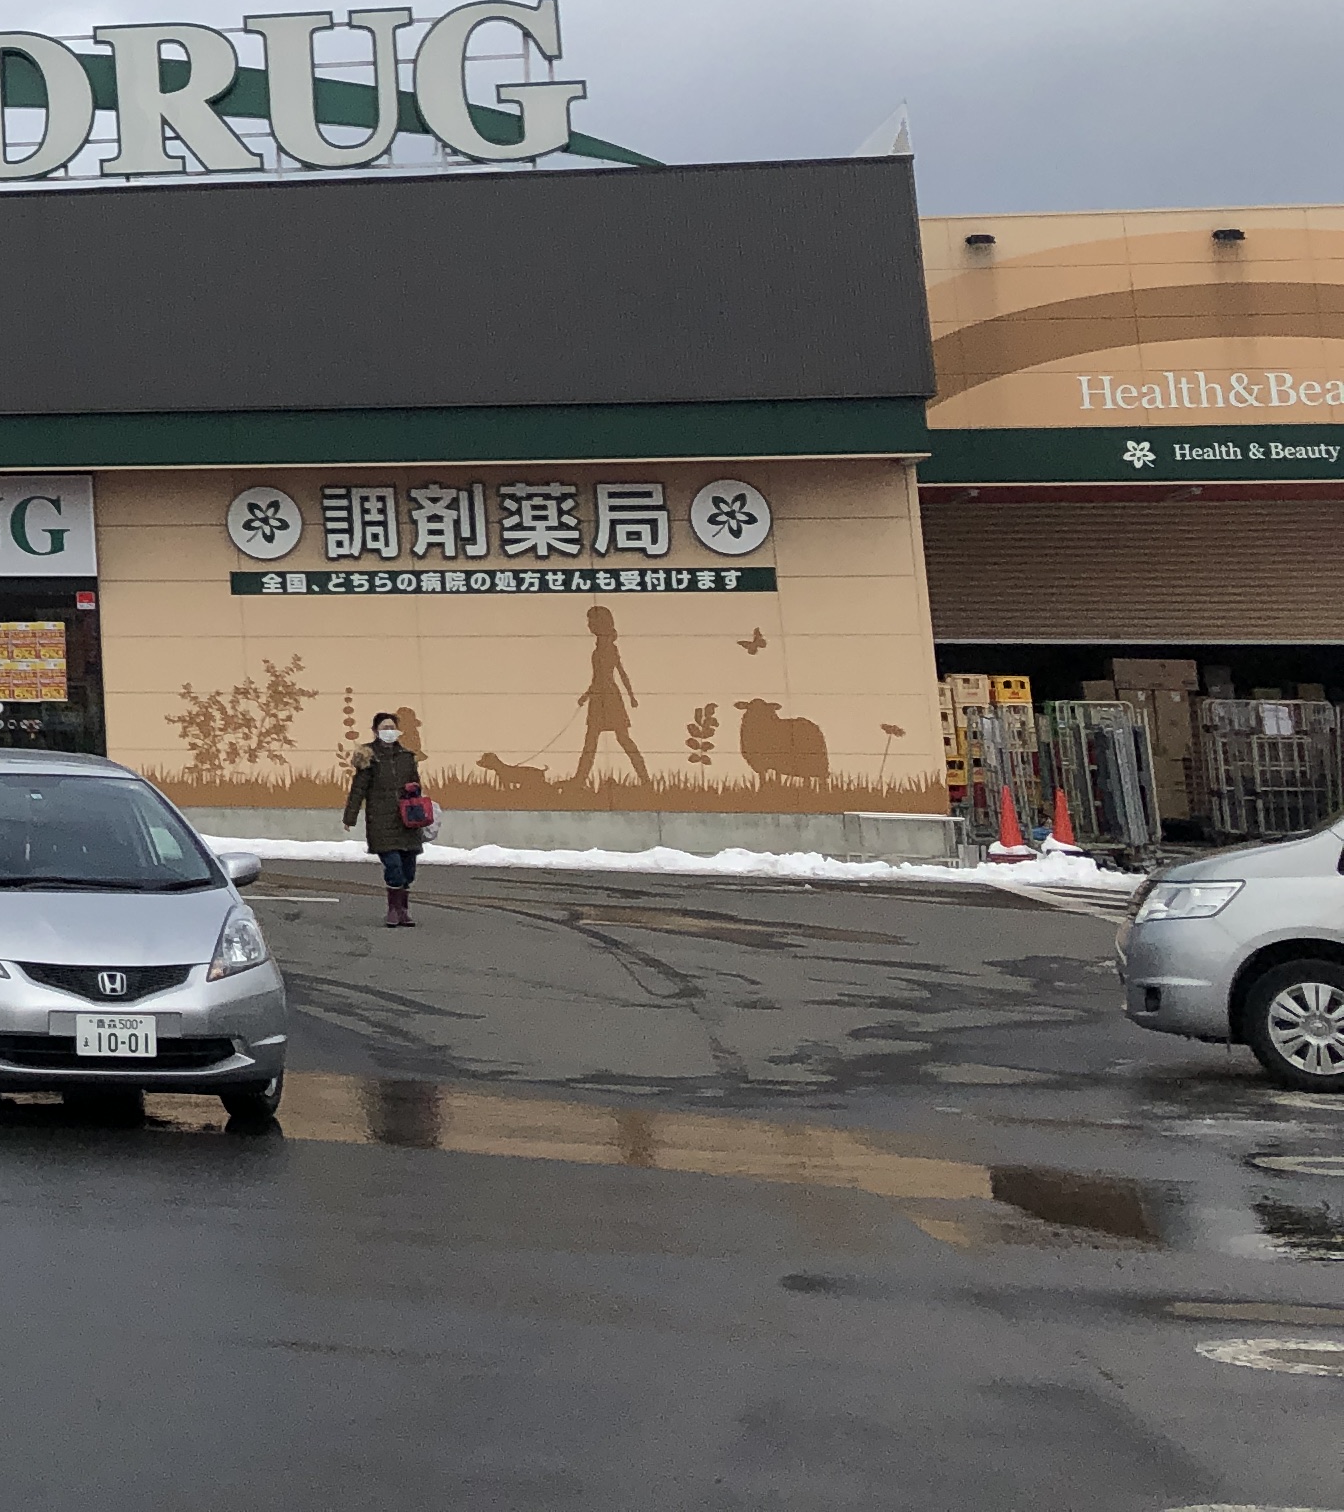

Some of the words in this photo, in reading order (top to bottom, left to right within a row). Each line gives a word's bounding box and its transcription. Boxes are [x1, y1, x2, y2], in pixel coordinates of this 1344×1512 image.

[1173, 442, 1243, 461] Health
[1248, 442, 1265, 460] &
[1269, 442, 1341, 463] Beauty
[321, 482, 670, 559] 調剤薬局
[261, 570, 742, 593] 全国、どちらの病院の処方せんも受付けます
[118, 1019, 138, 1030] 500
[98, 1032, 149, 1053] 10-01
